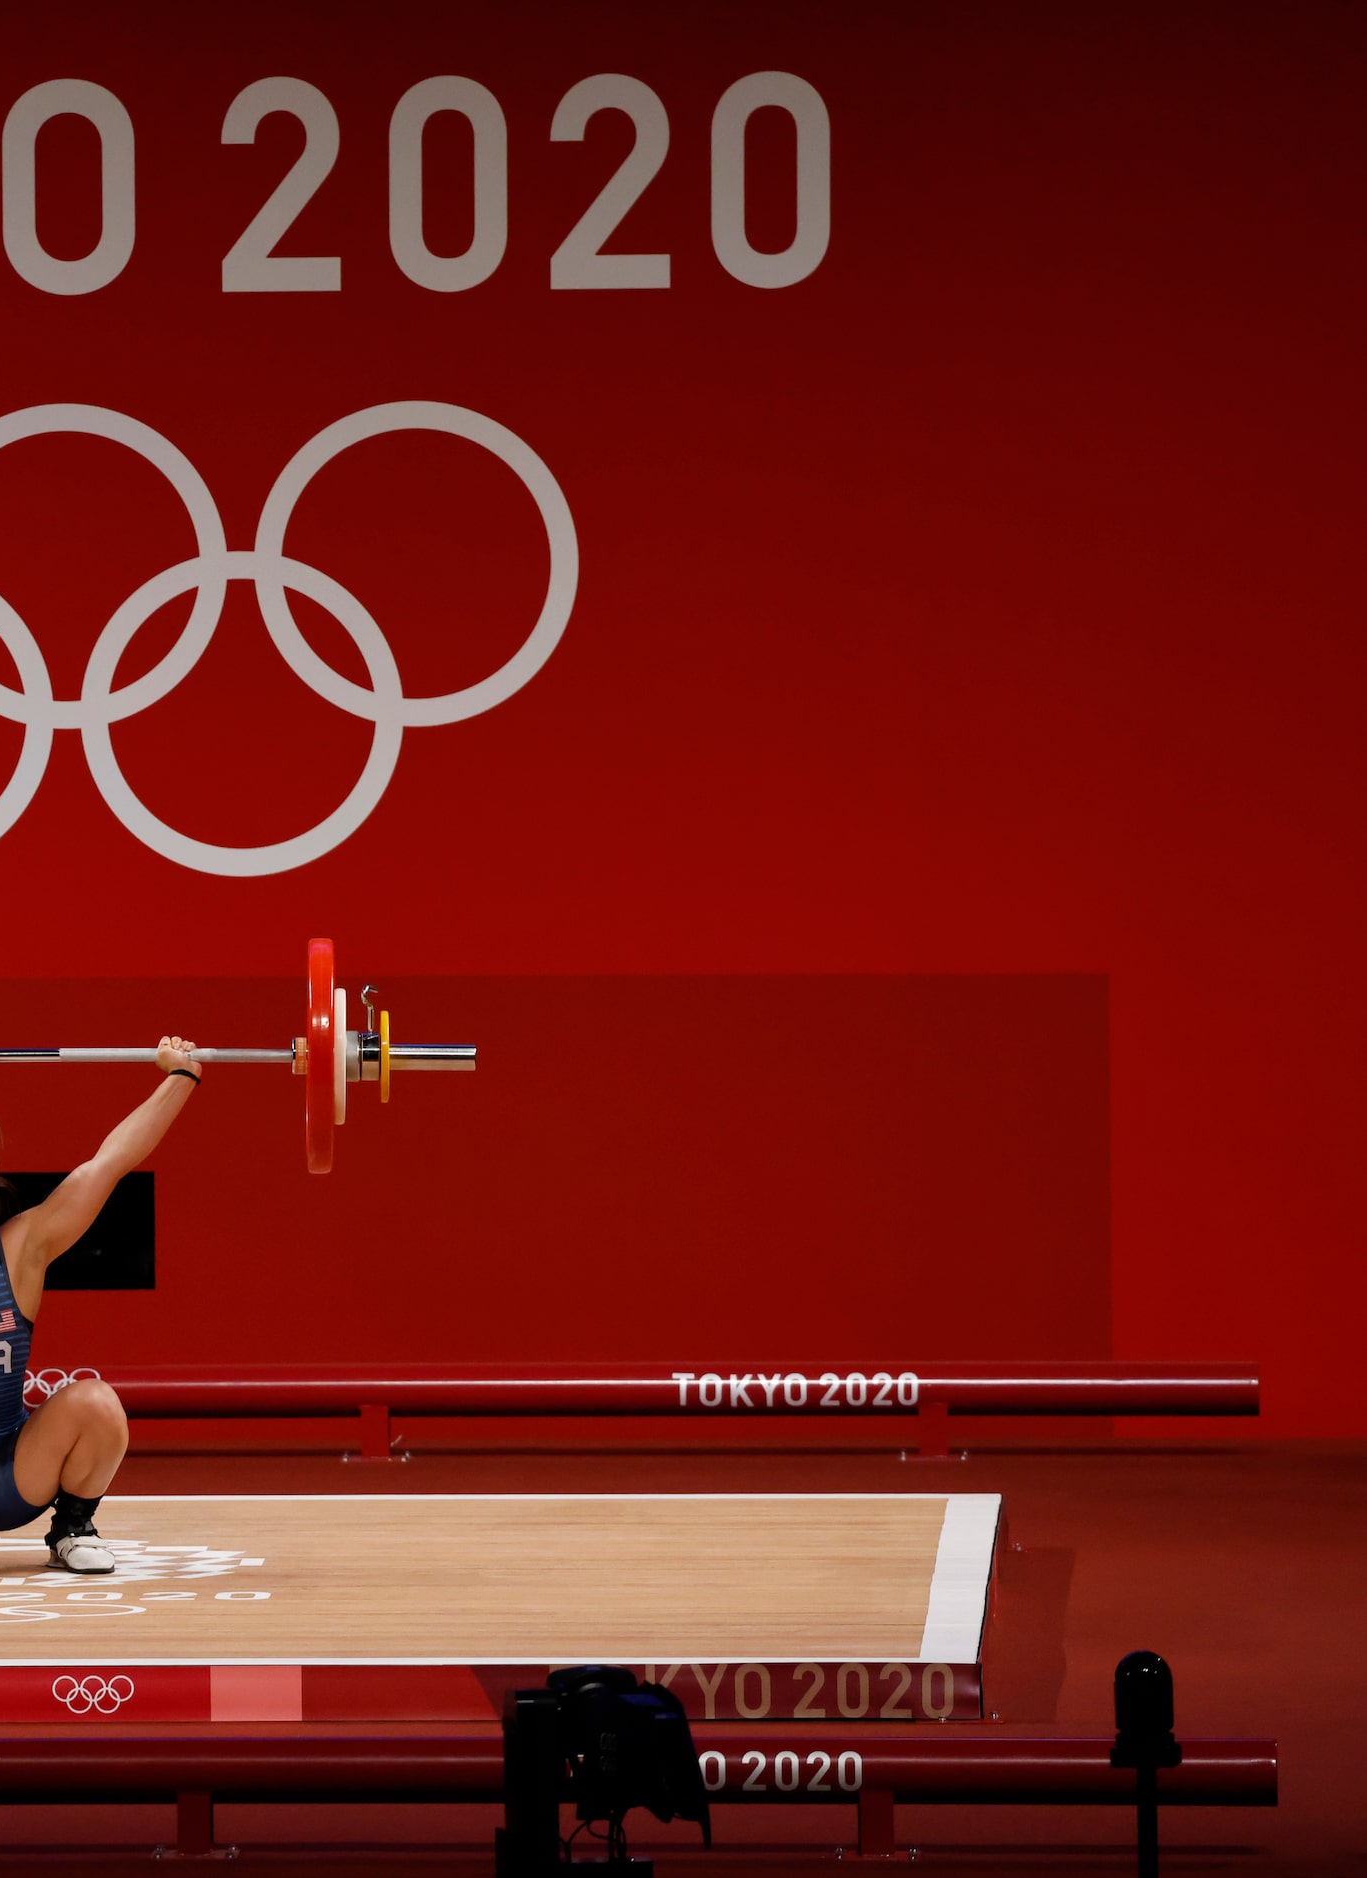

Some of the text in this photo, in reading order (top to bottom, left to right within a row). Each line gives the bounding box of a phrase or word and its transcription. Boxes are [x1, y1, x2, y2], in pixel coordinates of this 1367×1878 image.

[220, 70, 831, 293] 2020
[671, 1371, 920, 1408] TOKYO 2020
[792, 1661, 956, 1720] 2020
[741, 1750, 864, 1792] 2020
